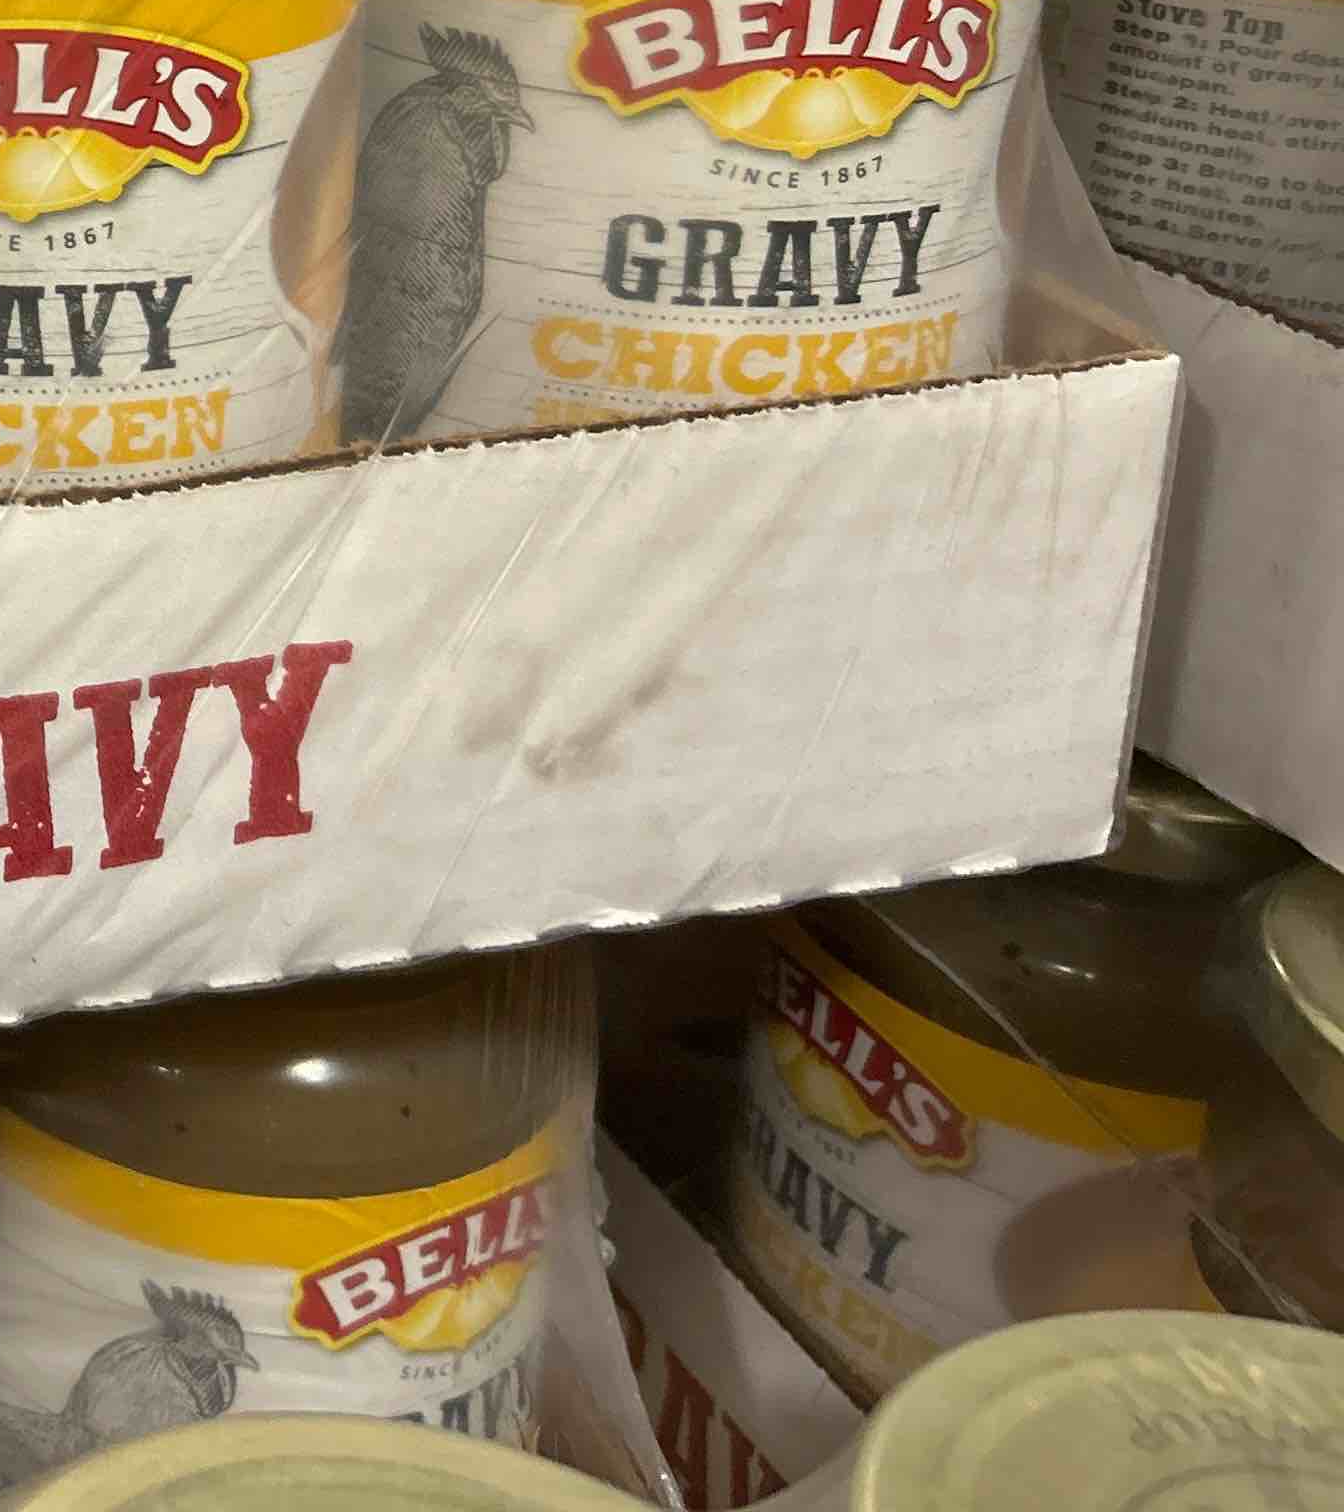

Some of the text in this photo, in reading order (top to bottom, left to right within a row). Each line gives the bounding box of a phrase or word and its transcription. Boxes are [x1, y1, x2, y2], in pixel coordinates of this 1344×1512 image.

[1112, 19, 1171, 44] Step
[1222, 9, 1284, 45] Top
[710, 154, 885, 190] SINCE 1867
[43, 221, 116, 252] 1867
[604, 204, 941, 308] GRAVY
[530, 312, 960, 399] CHICKEN
[752, 1108, 911, 1294] RAVY
